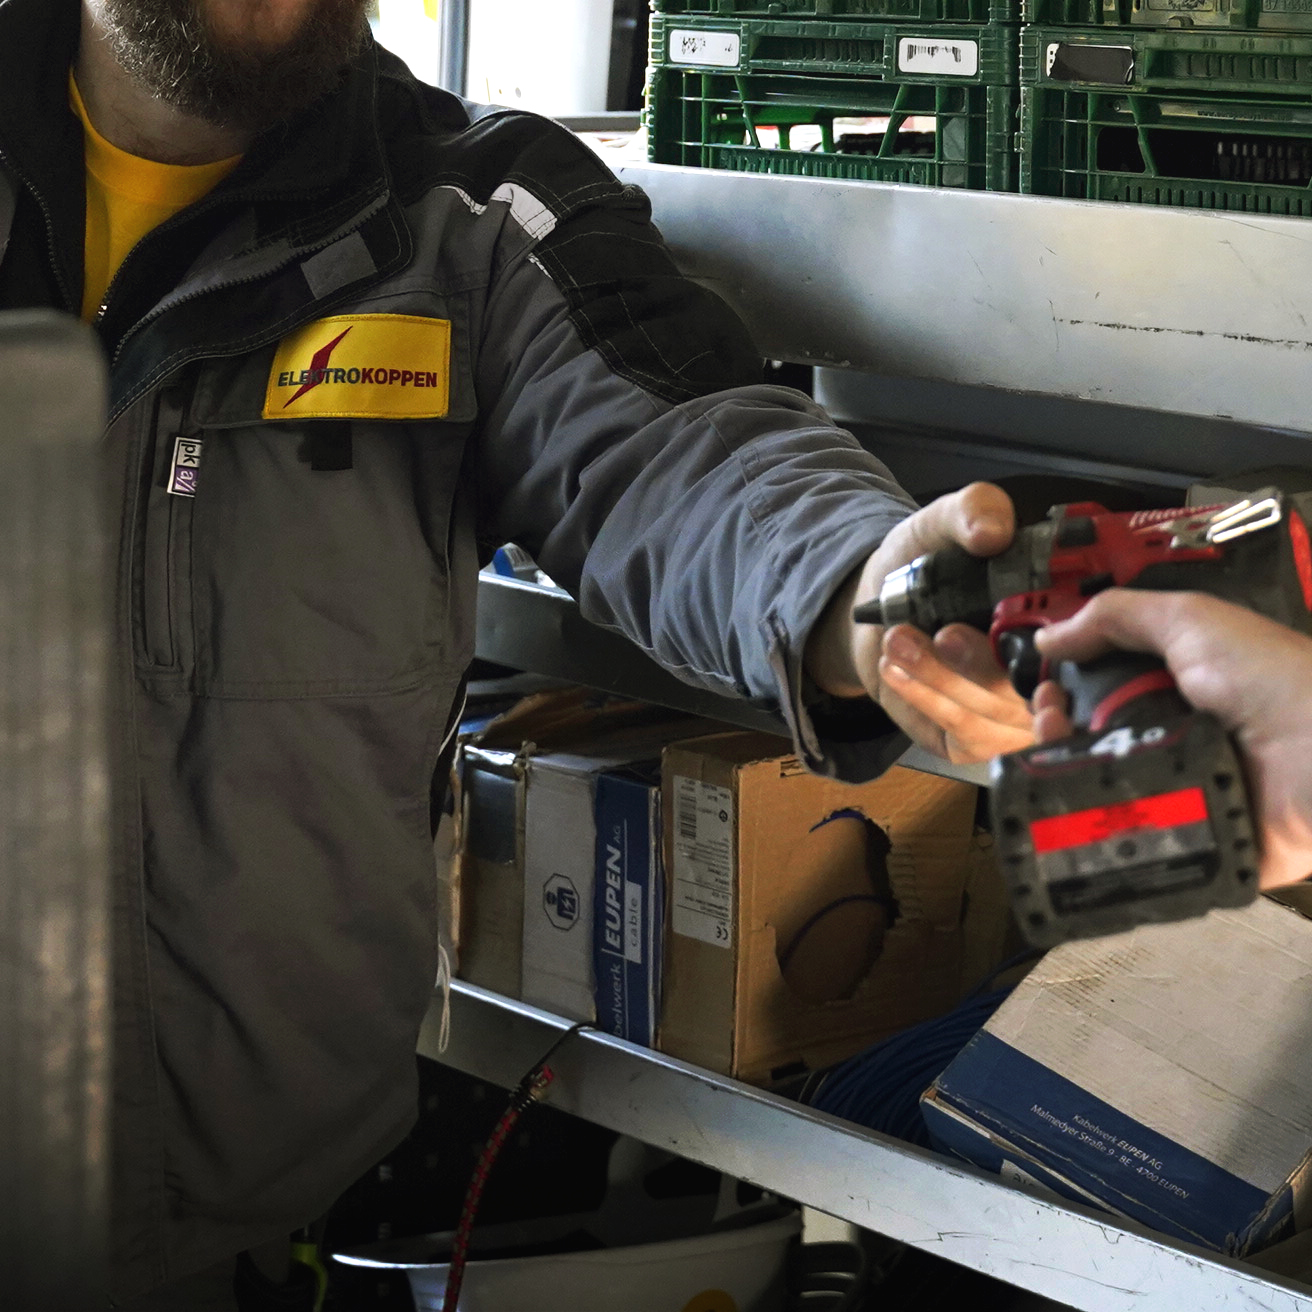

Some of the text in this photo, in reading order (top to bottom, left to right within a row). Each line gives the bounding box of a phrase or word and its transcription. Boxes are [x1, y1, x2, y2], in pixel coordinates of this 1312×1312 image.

[277, 367, 438, 388] ELEKTROKOPPEN
[605, 825, 623, 1037] belwerk EUPEN AG
[629, 897, 638, 947] cable
[1030, 1104, 1079, 1136] Malmedyer
[1078, 1131, 1107, 1152] Straße
[1107, 1148, 1115, 1156] 9
[1118, 1155, 1132, 1167] BE
[1135, 1166, 1159, 1182] 4700
[1158, 1178, 1190, 1199] EUPEN
[1072, 1114, 1164, 1170] Kabelwerk EUPEN AG
